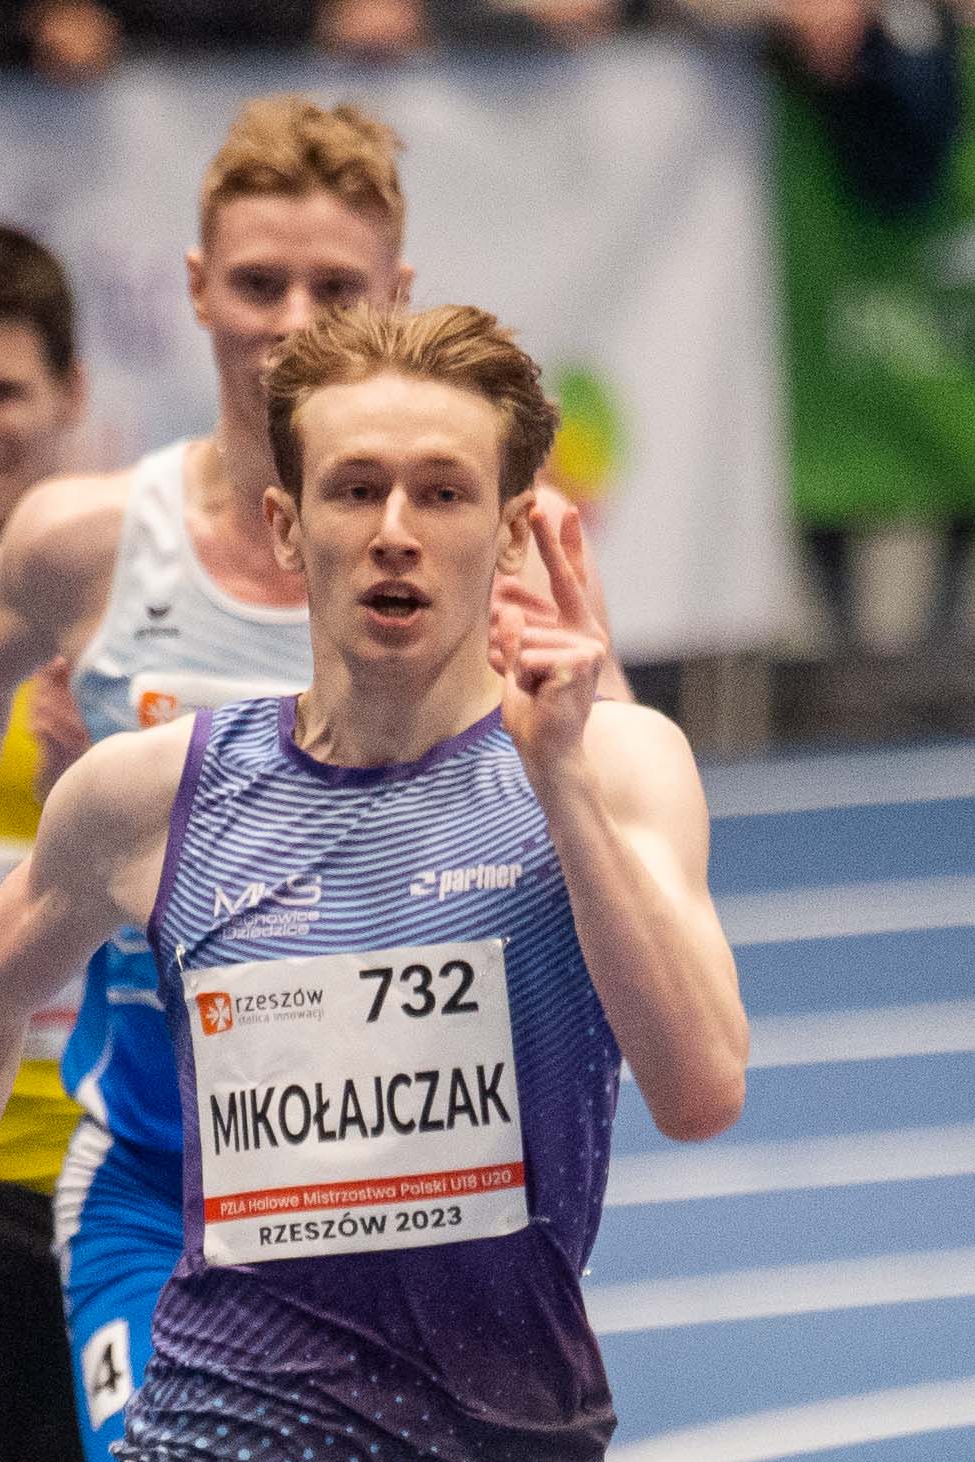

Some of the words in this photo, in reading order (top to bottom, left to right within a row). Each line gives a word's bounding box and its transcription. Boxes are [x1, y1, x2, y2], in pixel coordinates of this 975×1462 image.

[439, 864, 523, 901] partner
[236, 988, 323, 1013] rzeszów
[359, 960, 479, 1023] 732
[210, 1062, 512, 1155] MIKOŁAJCZAK
[220, 1201, 246, 1217] PZLA
[249, 1195, 299, 1212] Halowe
[303, 1185, 397, 1206] Mistrzostwa
[400, 1179, 447, 1196] Polski
[481, 1169, 513, 1186] U20
[259, 1211, 387, 1246] RZESZÓW
[395, 1205, 462, 1232] 2023
[92, 1341, 122, 1397] 4
